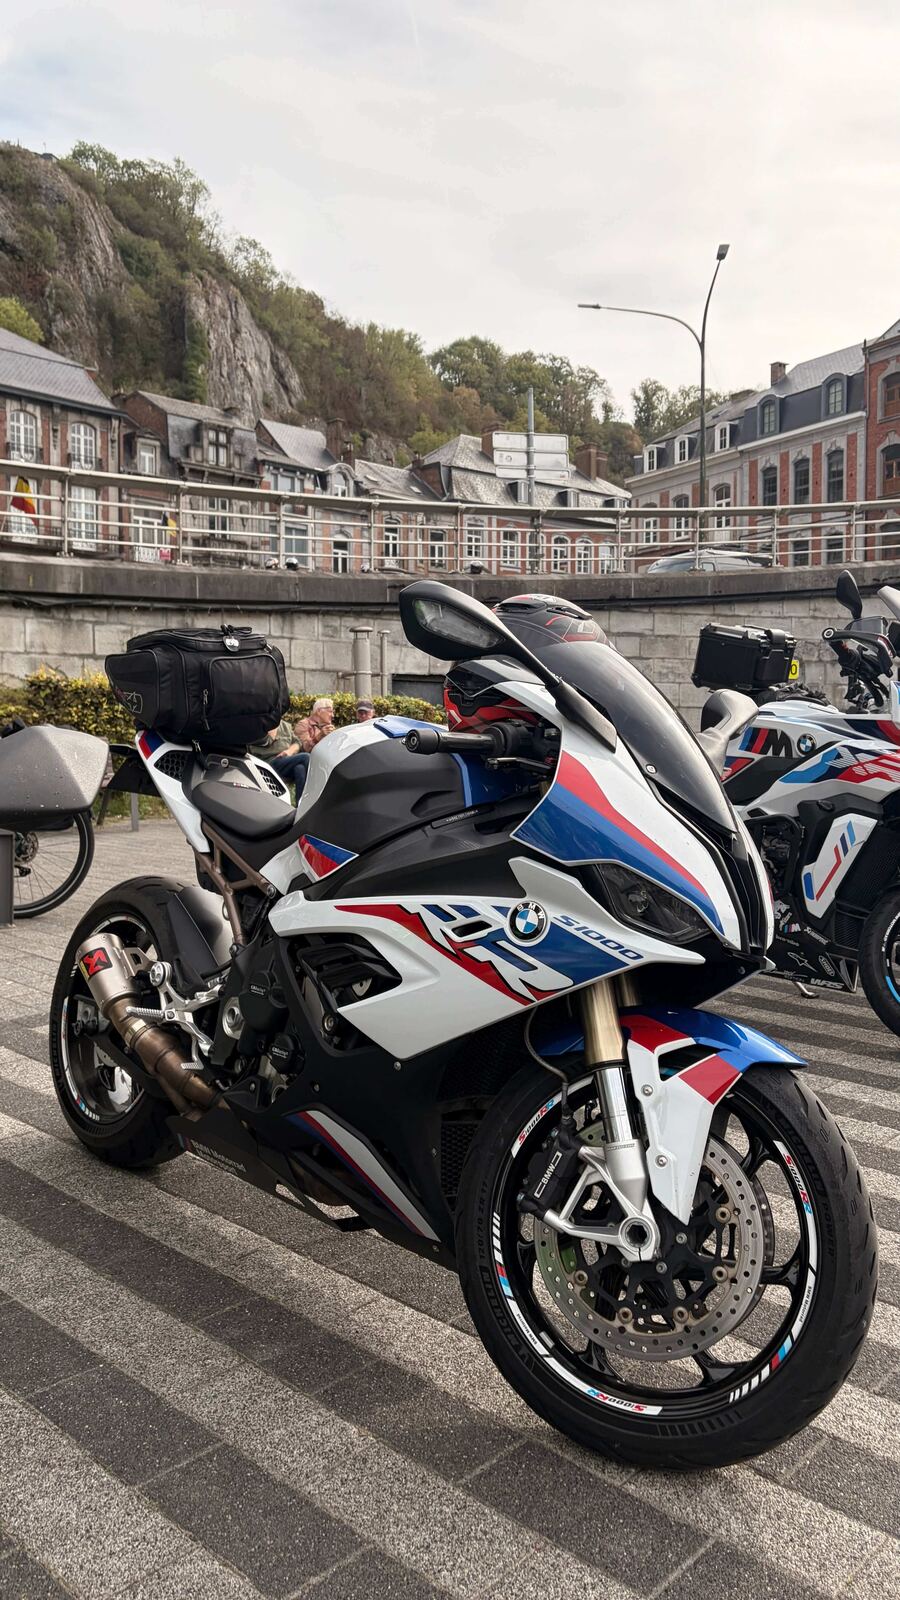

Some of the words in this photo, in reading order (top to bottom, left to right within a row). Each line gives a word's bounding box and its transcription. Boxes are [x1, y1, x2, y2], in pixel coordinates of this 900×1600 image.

[553, 914, 644, 961] S1000
[518, 1098, 555, 1145] S1000RR
[541, 1162, 556, 1185] BMW
[784, 1154, 812, 1214] S1000RR
[482, 1270, 522, 1352] MICHELIN
[587, 1388, 648, 1412] S1000RR
